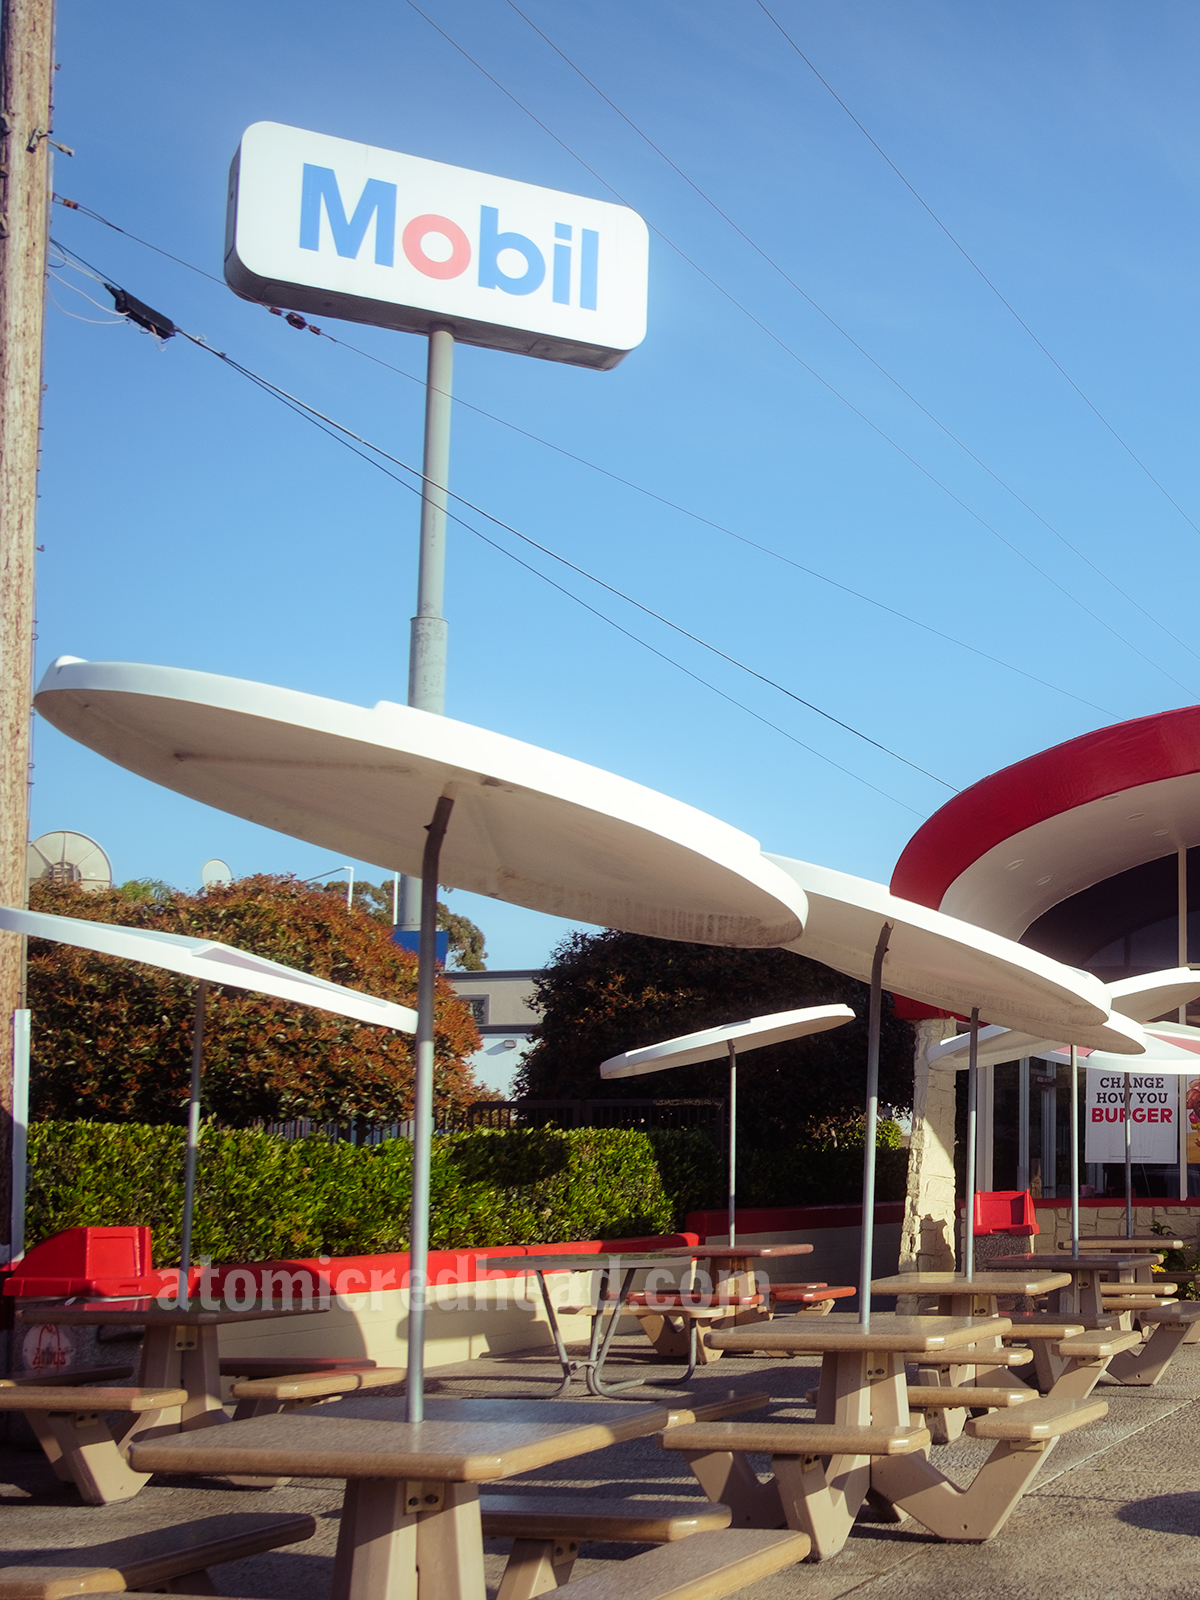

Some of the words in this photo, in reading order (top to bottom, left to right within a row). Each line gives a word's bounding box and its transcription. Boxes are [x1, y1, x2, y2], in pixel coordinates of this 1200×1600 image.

[299, 162, 599, 311] Mobil
[1100, 1077, 1164, 1089] CHANGE
[1096, 1092, 1133, 1104] HOW
[1137, 1092, 1169, 1104] YOU
[1092, 1107, 1173, 1123] BURGER
